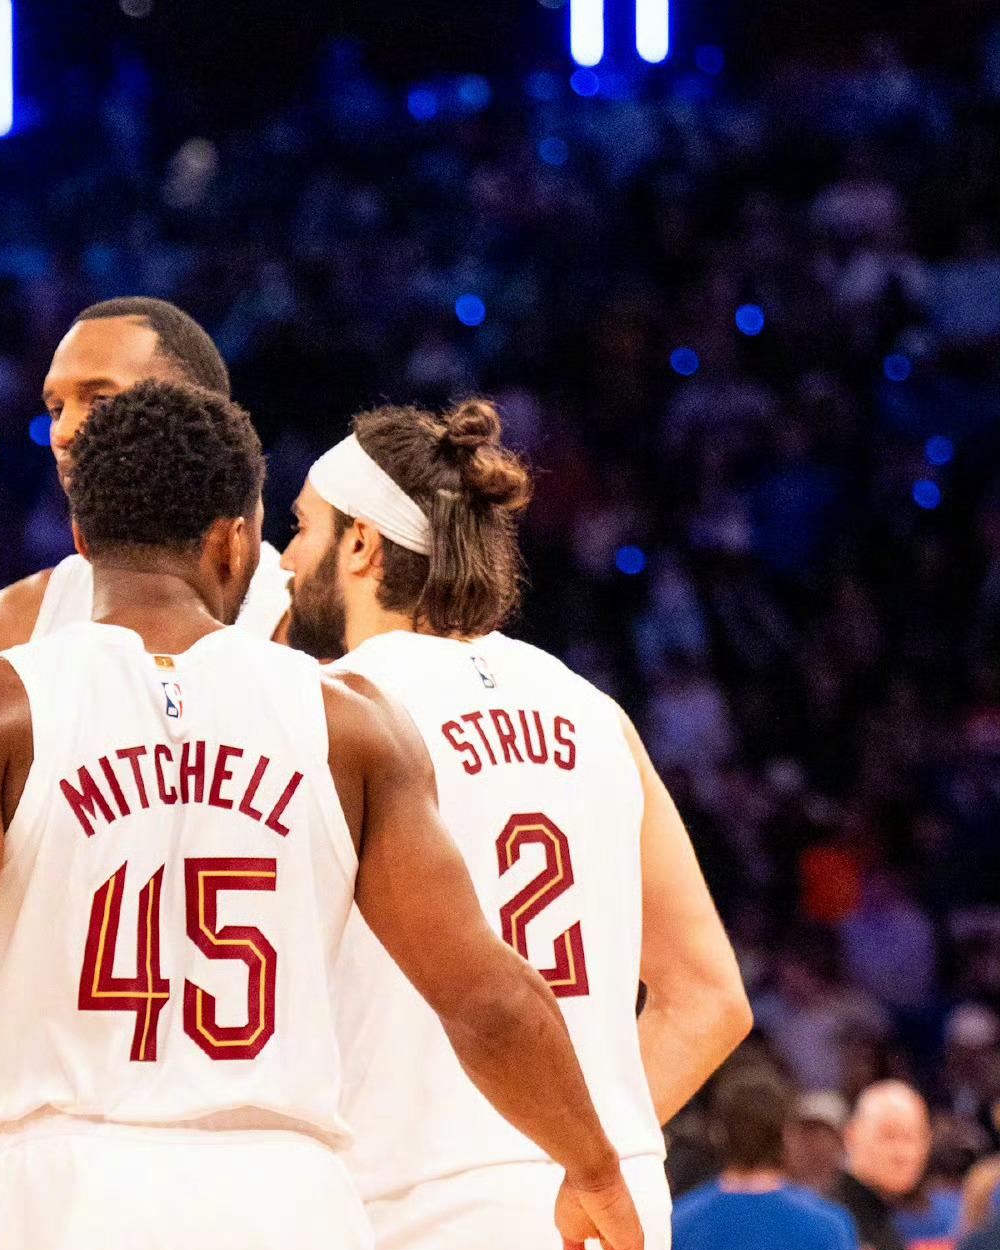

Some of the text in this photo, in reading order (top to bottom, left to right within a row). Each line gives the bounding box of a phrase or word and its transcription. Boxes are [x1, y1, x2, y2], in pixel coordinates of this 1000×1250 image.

[58, 740, 305, 838] MITCHELL
[441, 709, 577, 775] STRUS
[76, 857, 278, 1063] 45
[495, 812, 590, 998] 2
